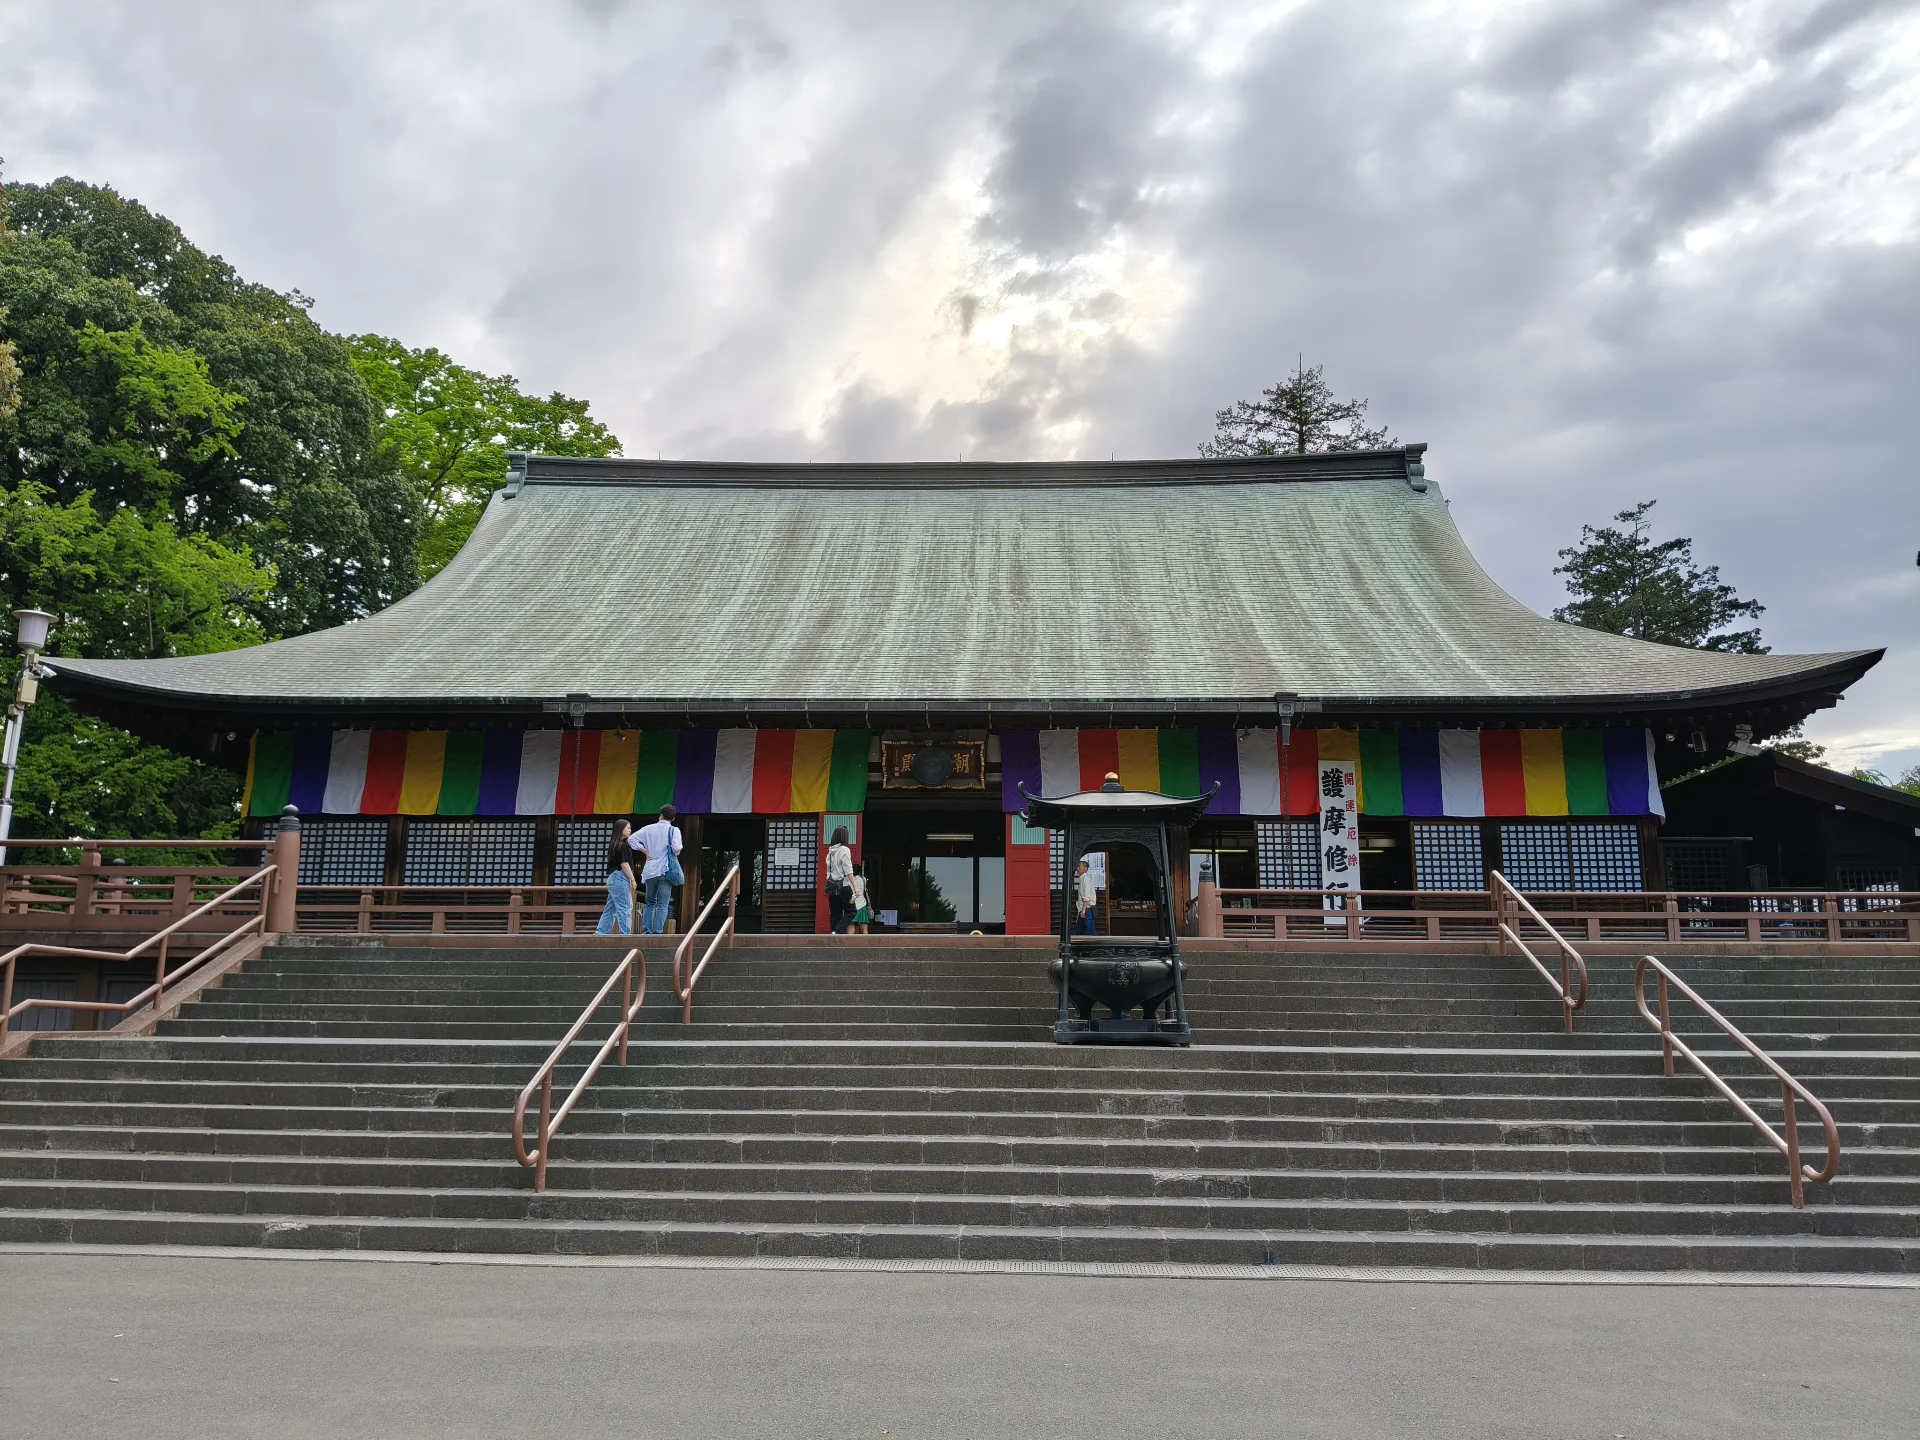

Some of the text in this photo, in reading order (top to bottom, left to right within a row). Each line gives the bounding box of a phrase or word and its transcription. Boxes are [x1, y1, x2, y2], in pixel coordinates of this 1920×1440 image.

[1321, 768, 1349, 910] 護摩修行
[1344, 772, 1358, 867] 開運厄除
